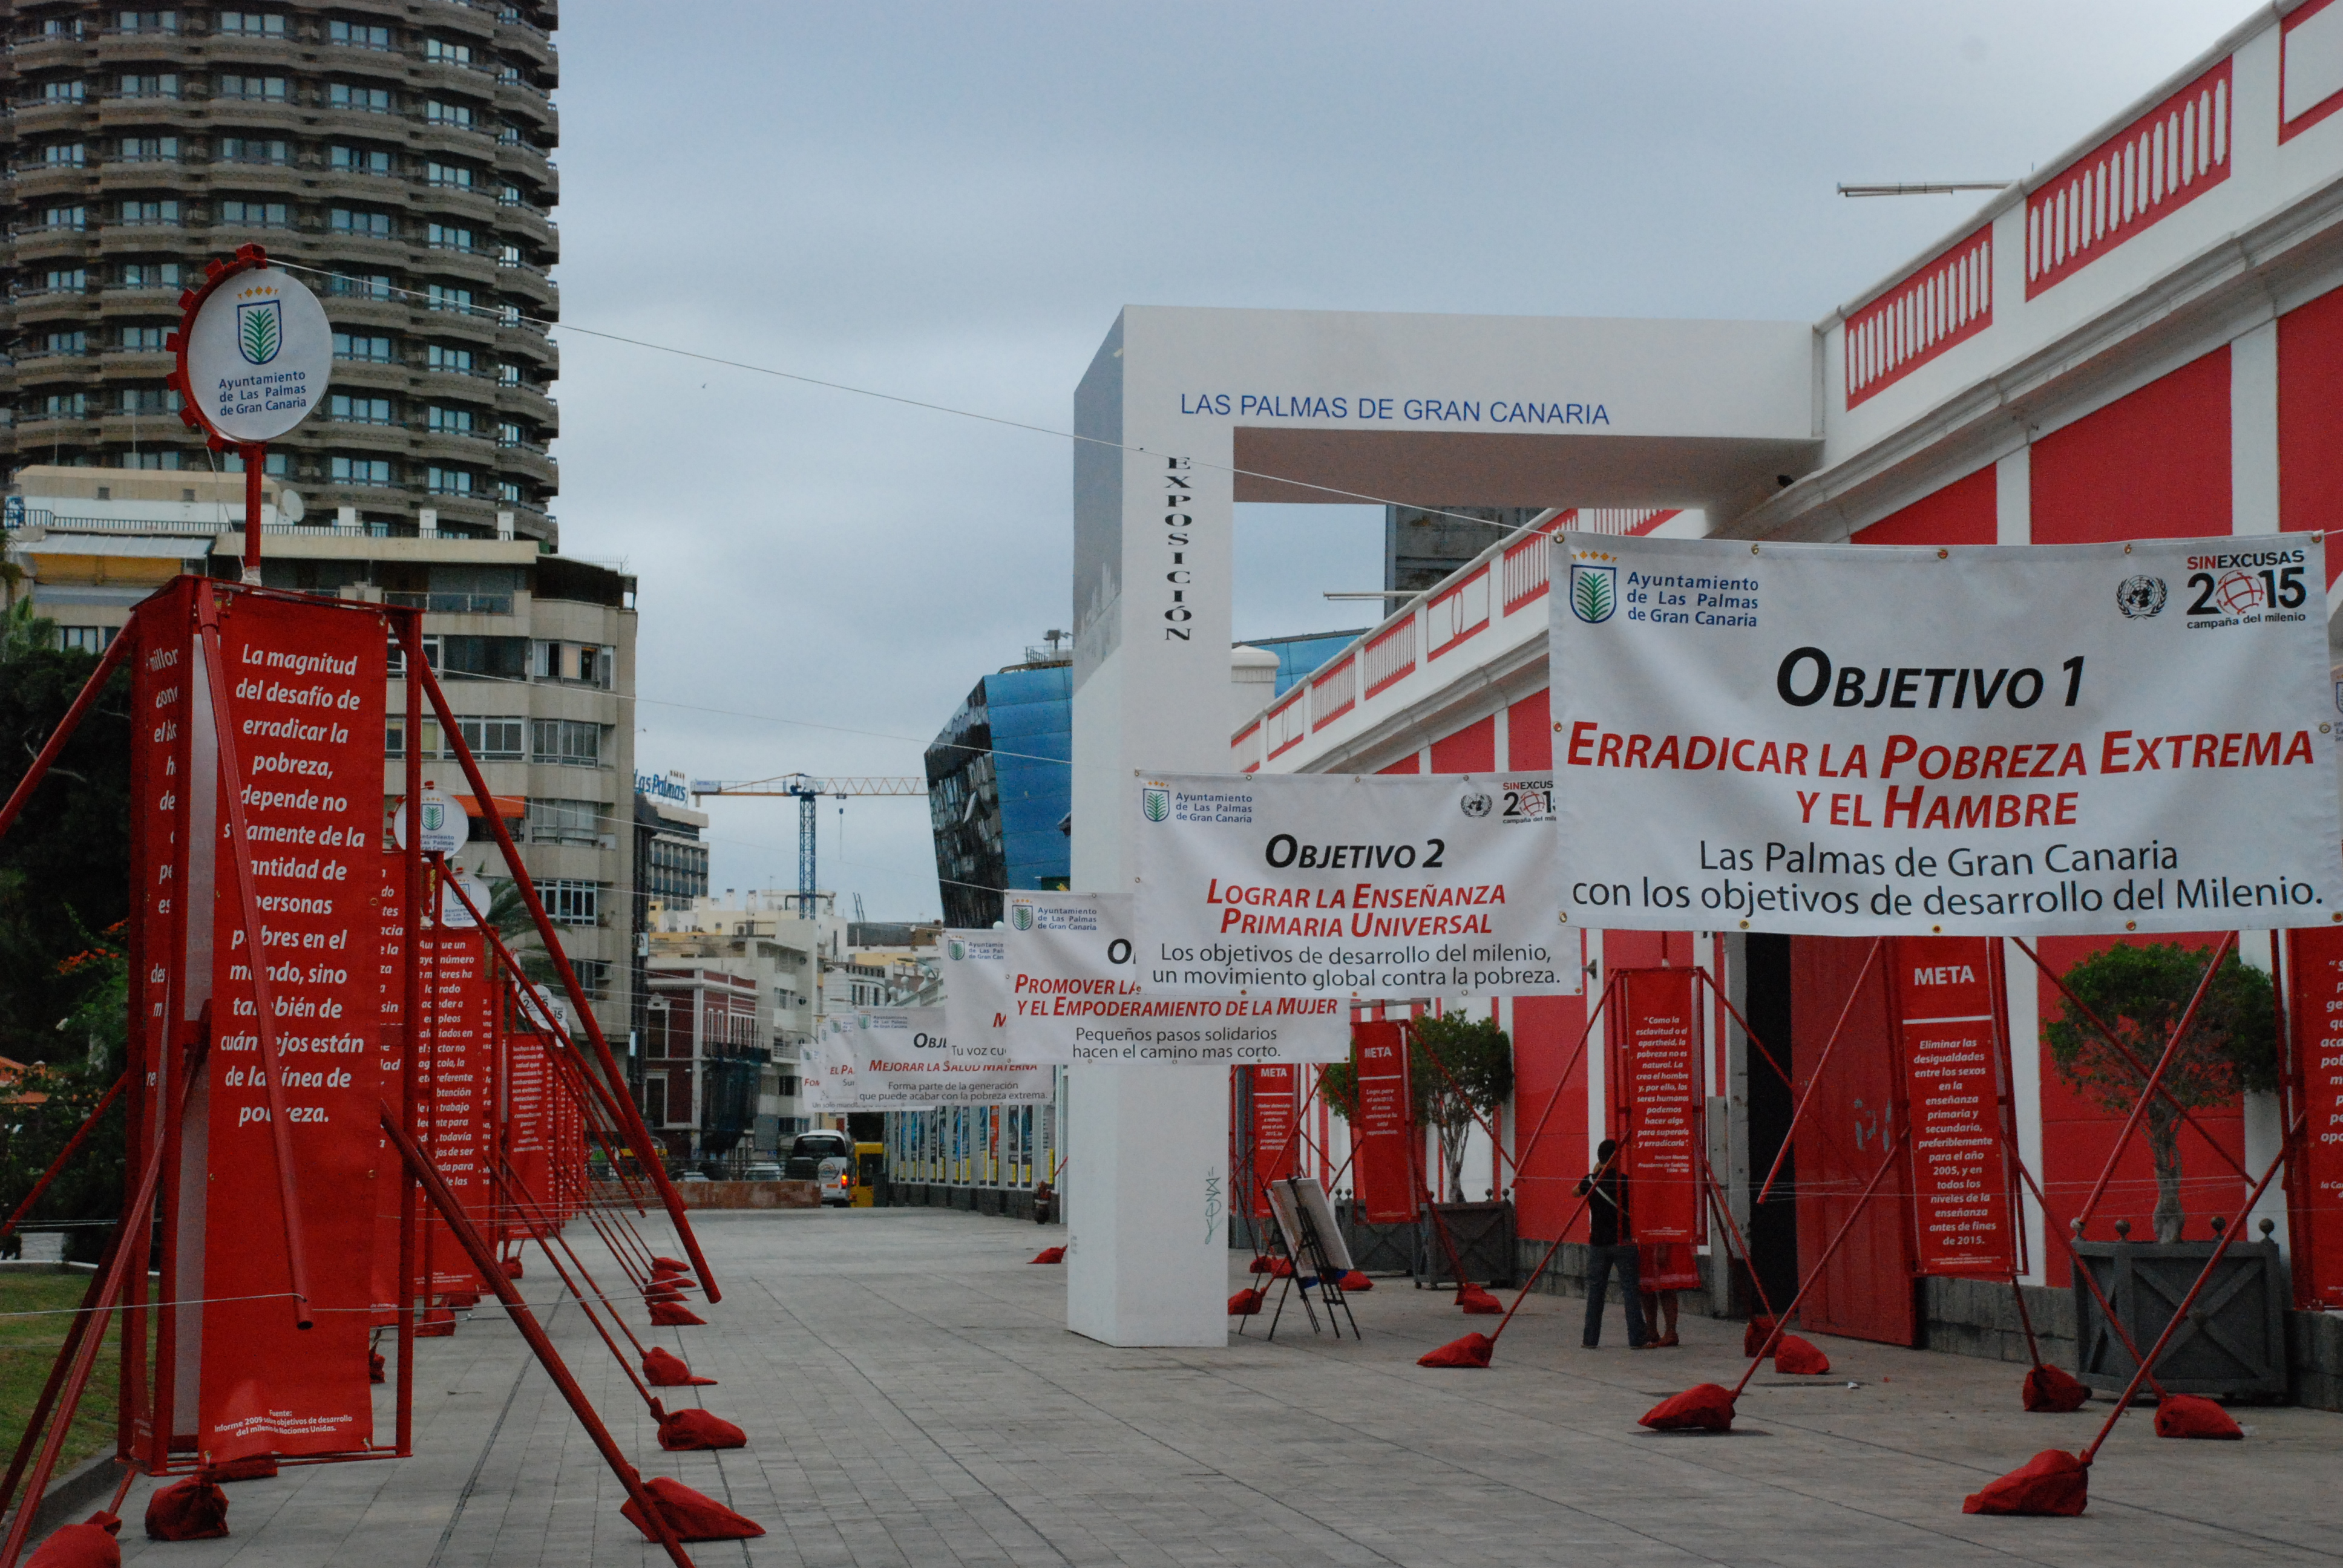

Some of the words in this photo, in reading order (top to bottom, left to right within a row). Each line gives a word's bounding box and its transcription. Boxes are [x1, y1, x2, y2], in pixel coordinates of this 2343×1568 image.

[219, 371, 305, 391] Ayuntamiento
[220, 391, 233, 402] de
[241, 390, 258, 400] Las
[266, 385, 306, 397] Palmas
[220, 405, 233, 416] de
[237, 403, 261, 414] Gran
[266, 397, 306, 410] Canaria
[1181, 394, 1230, 415] LAS
[1241, 396, 1347, 418] PALMAS
[1359, 398, 1392, 419] DE
[1403, 399, 1480, 422] GRAN
[1490, 402, 1610, 425] CANARIA
[1164, 456, 1192, 641] EXPOSICIÓN
[2187, 550, 2305, 570] SINEXCUSAS
[1627, 571, 1758, 591] Ayuntamiento
[1627, 589, 1647, 604] de
[1659, 592, 1686, 606] Las
[1697, 593, 1758, 609] Palmas
[1628, 607, 1645, 621] de
[1650, 609, 1688, 624] Gran
[1695, 611, 1757, 627] Canaria
[2187, 617, 2239, 630] campaña
[2243, 613, 2261, 624] del
[2265, 612, 2305, 622] milenio
[242, 643, 264, 665] La
[267, 650, 358, 676] magnitud
[1777, 646, 2045, 709] OBJETIVO
[2063, 655, 2085, 707] 1
[236, 678, 263, 700] del
[266, 681, 333, 708] desafío
[337, 690, 360, 710] de
[243, 717, 327, 741] erradicar
[330, 722, 349, 743] la
[1567, 720, 1809, 776] ERRADICAR
[1818, 744, 1867, 779] LA
[1879, 734, 2087, 780] POBREZA
[2100, 729, 2313, 774] EXTREMA
[252, 752, 333, 779] pobreza,
[241, 784, 318, 810] depende
[322, 795, 347, 812] no
[652, 774, 686, 802] Palmas
[1176, 792, 1252, 802] Ayuntamiento
[1194, 803, 1210, 812] Las
[1216, 804, 1252, 812] Palmas
[1795, 791, 1820, 823] Y
[1830, 793, 1872, 827] EL
[1883, 785, 2079, 829] HAMBRE
[1216, 814, 1252, 823] Canaria
[320, 825, 342, 846] de
[346, 826, 365, 847] la
[1265, 834, 1416, 868] OBJETIVO
[1422, 838, 1445, 867] 2
[1700, 840, 1754, 871] Las
[1766, 841, 1886, 875] Palmas
[1895, 848, 1937, 877] de
[1948, 848, 2033, 877] Gran
[2045, 840, 2178, 873] Canaria
[322, 860, 347, 880] de
[1207, 878, 1310, 908] LOGRAR
[1316, 889, 1345, 908] LA
[1352, 884, 1506, 909] ENSEÑANZA
[1573, 881, 1630, 906] con
[1643, 877, 1689, 907] los
[1701, 879, 1859, 918] objetivos
[1870, 886, 1912, 915] de
[1924, 881, 2103, 915] desarrollo
[2113, 878, 2163, 911] del
[2178, 876, 2322, 909] Milenio.
[1221, 908, 1343, 936] PRIMARIA
[1351, 912, 1492, 937] UNIVERSAL
[303, 930, 324, 947] en
[329, 929, 347, 949] el
[440, 955, 474, 964] número
[1161, 943, 1193, 961] Los
[1200, 944, 1293, 966] objetivos
[1299, 947, 1322, 964] de
[1329, 946, 1429, 965] desarrollo
[1436, 944, 1466, 962] del
[1473, 944, 1551, 962] milenio,
[309, 964, 347, 984] sino
[1153, 970, 1176, 983] un
[1185, 968, 1306, 985] movimiento
[1313, 969, 1375, 990] global
[1382, 970, 1446, 985] contra
[1453, 967, 1467, 985] la
[1475, 967, 1560, 988] pobreza.
[1915, 965, 1974, 985] META
[1015, 974, 1115, 995] PROMOVER
[320, 998, 342, 1018] de
[1017, 1001, 1027, 1015] Y
[1031, 1001, 1048, 1016] EL
[1053, 996, 1222, 1017] EMPODERAMIENTO
[1225, 1001, 1248, 1016] DE
[1252, 1001, 1273, 1016] LA
[1277, 997, 1337, 1015] MUJER
[221, 1030, 258, 1051] cuán
[311, 1033, 364, 1053] están
[1076, 1027, 1152, 1044] Pequeños
[1157, 1030, 1200, 1044] pasos
[1205, 1027, 1277, 1041] solidarios
[1919, 1040, 1960, 1050] Eliminar
[1073, 1044, 1117, 1058] hacen
[1123, 1045, 1135, 1058] el
[1141, 1045, 1197, 1059] camino
[1202, 1047, 1232, 1058] mas
[1237, 1046, 1280, 1057] corto.
[1914, 1052, 1985, 1065] desigualdades
[869, 1060, 924, 1071] MEJORAR
[927, 1063, 939, 1071] LA
[1261, 1068, 1287, 1077] META
[225, 1065, 244, 1086] de
[247, 1066, 266, 1086] la
[326, 1067, 352, 1088] de
[919, 1083, 943, 1091] parte
[968, 1082, 1018, 1091] generación
[879, 1093, 907, 1101] puede
[971, 1093, 1006, 1102] pobreza
[1925, 1096, 1979, 1105] enseñanza
[440, 1102, 470, 1114] trabajo
[1928, 1110, 1970, 1121] primaria
[1919, 1137, 1993, 1149] preferiblemente
[215, 1422, 243, 1432] Informe
[244, 1417, 263, 1425] 2009
[318, 1415, 352, 1423] desarrollo
